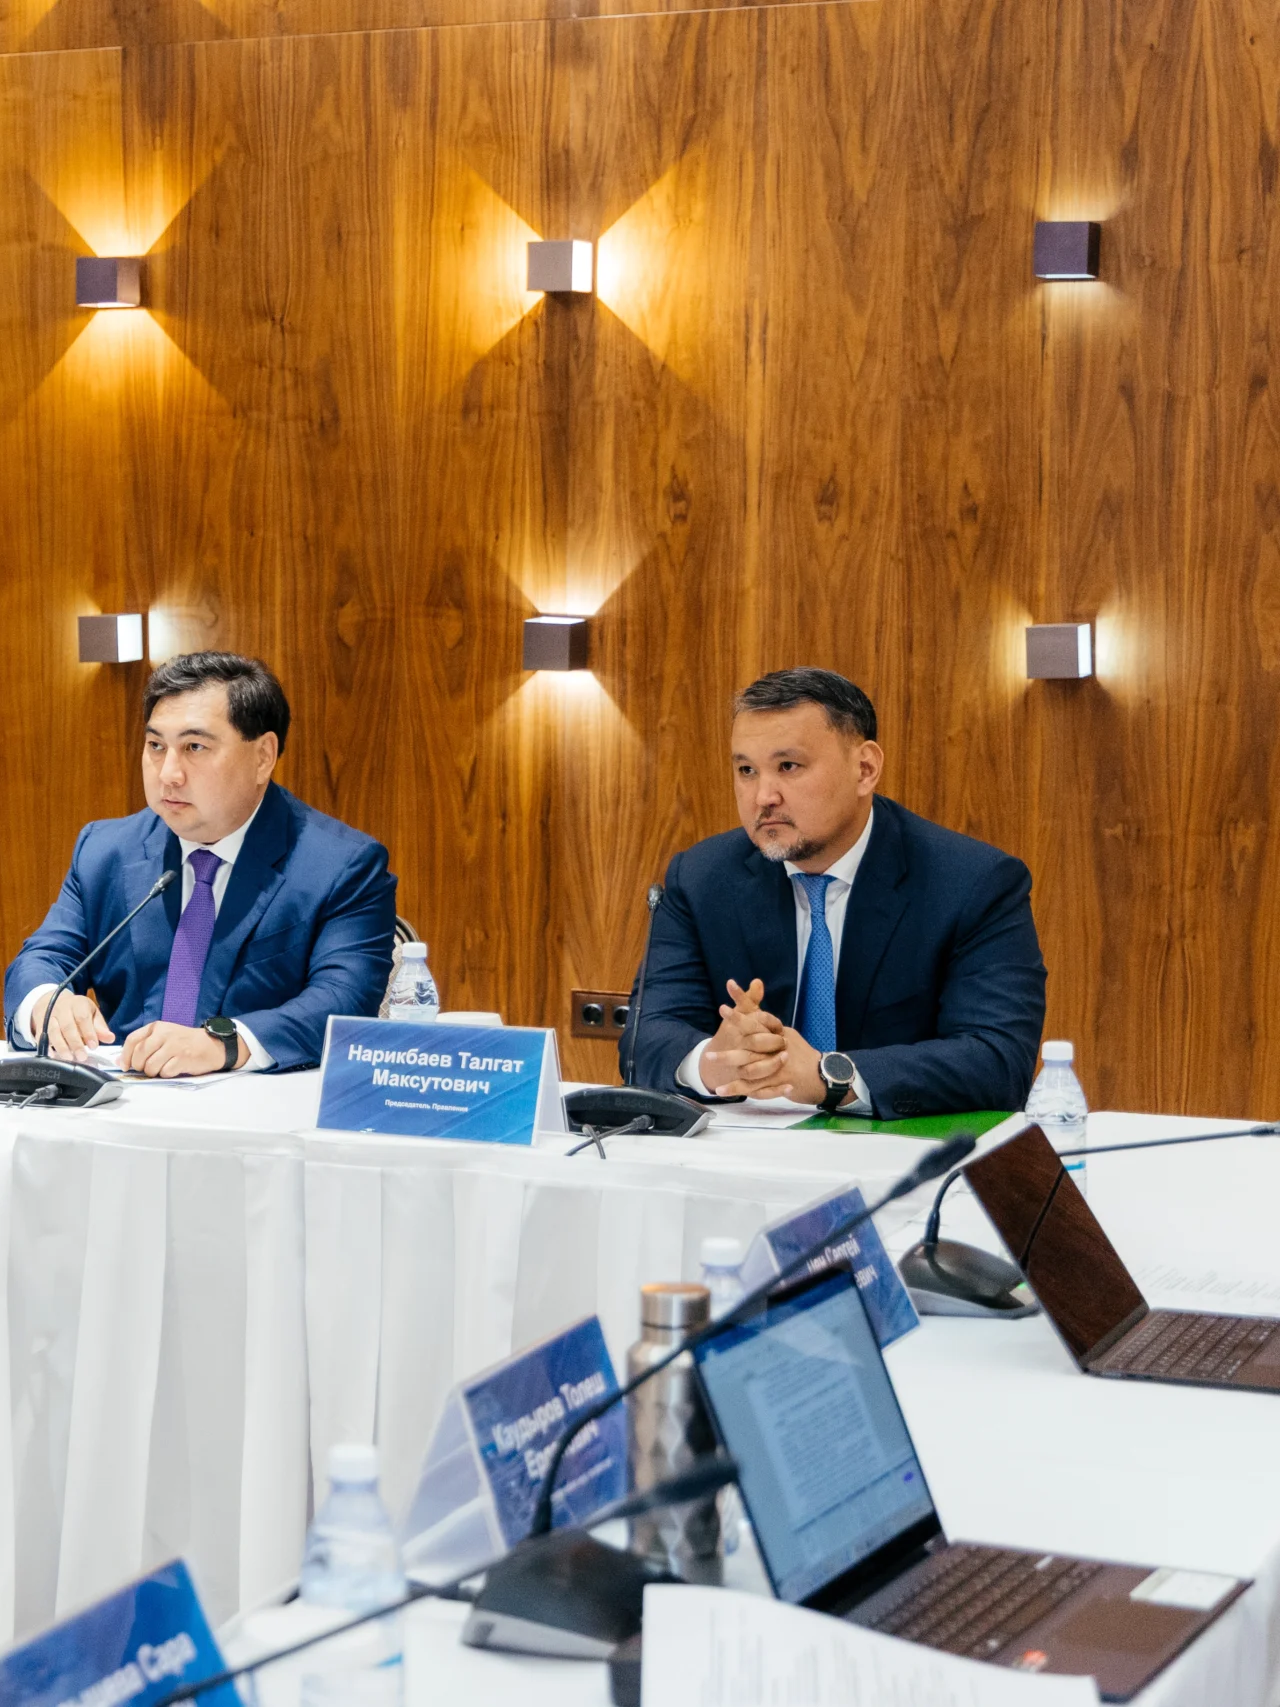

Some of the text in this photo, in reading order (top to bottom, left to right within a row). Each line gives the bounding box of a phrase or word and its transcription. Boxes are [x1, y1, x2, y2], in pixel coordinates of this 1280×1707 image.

[348, 1044, 524, 1074] Нарикбаев Талгат
[27, 1067, 61, 1080] BOSCH
[372, 1069, 490, 1094] Максутович
[384, 1099, 469, 1112] Председатель Правления
